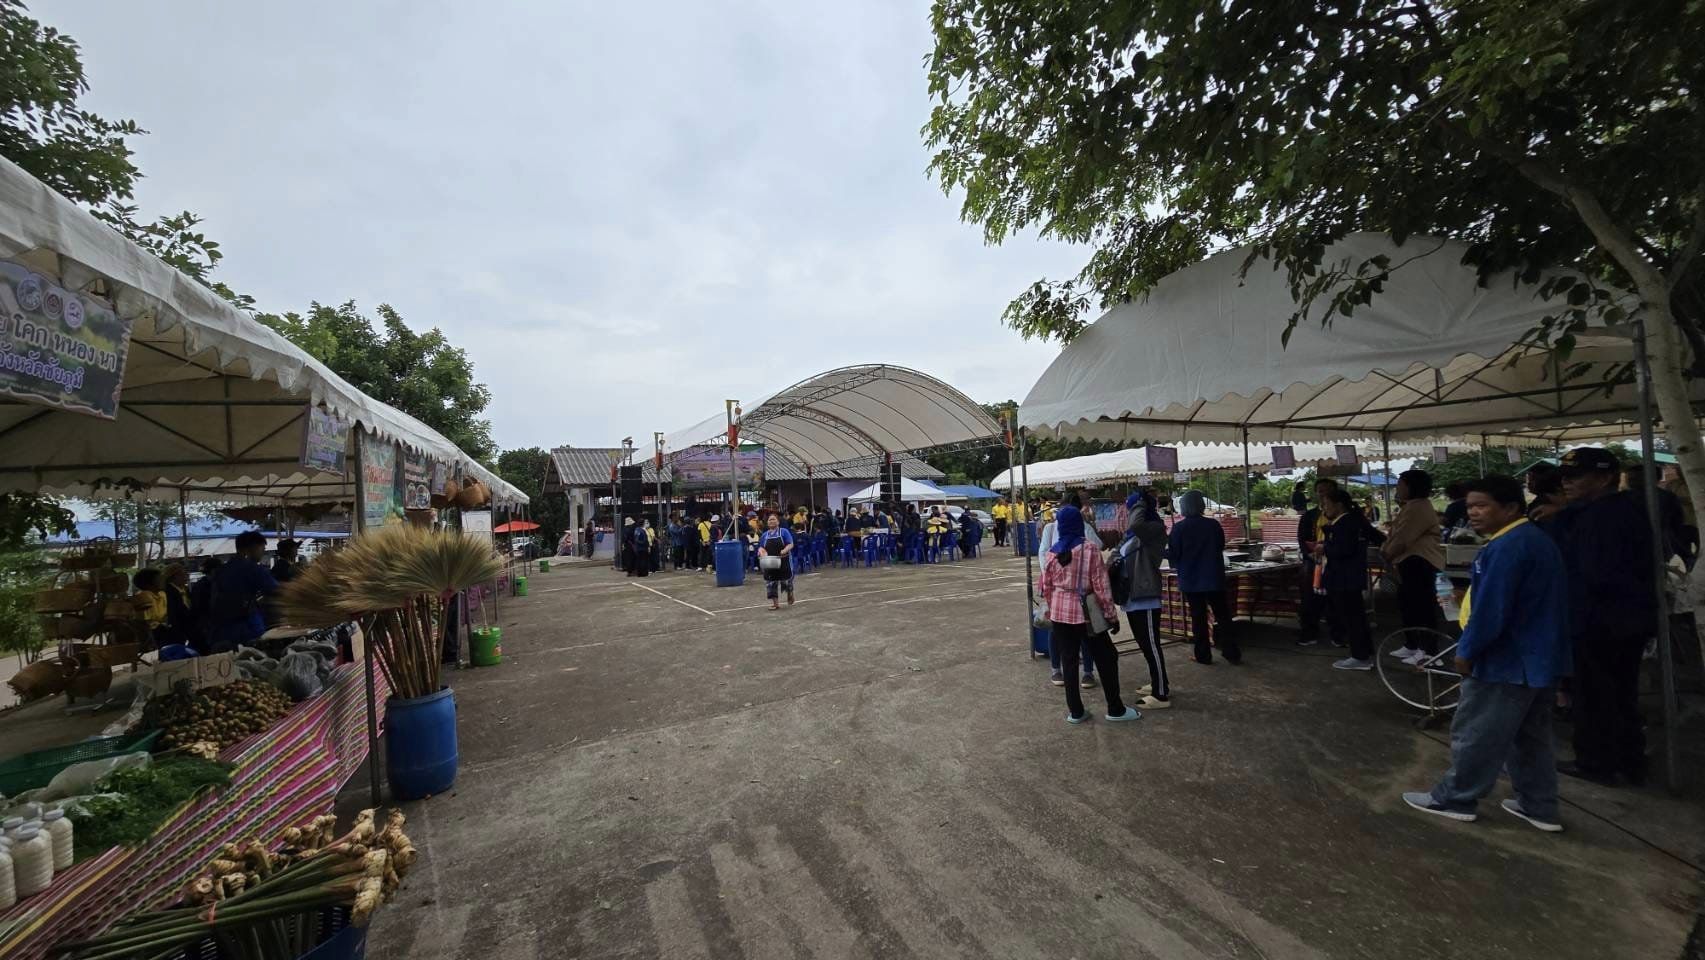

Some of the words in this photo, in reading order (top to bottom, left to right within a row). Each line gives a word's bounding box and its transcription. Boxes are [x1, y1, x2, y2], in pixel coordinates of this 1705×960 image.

[13, 313, 48, 348] โคก
[53, 332, 95, 366] หนอง
[99, 350, 118, 373] นา
